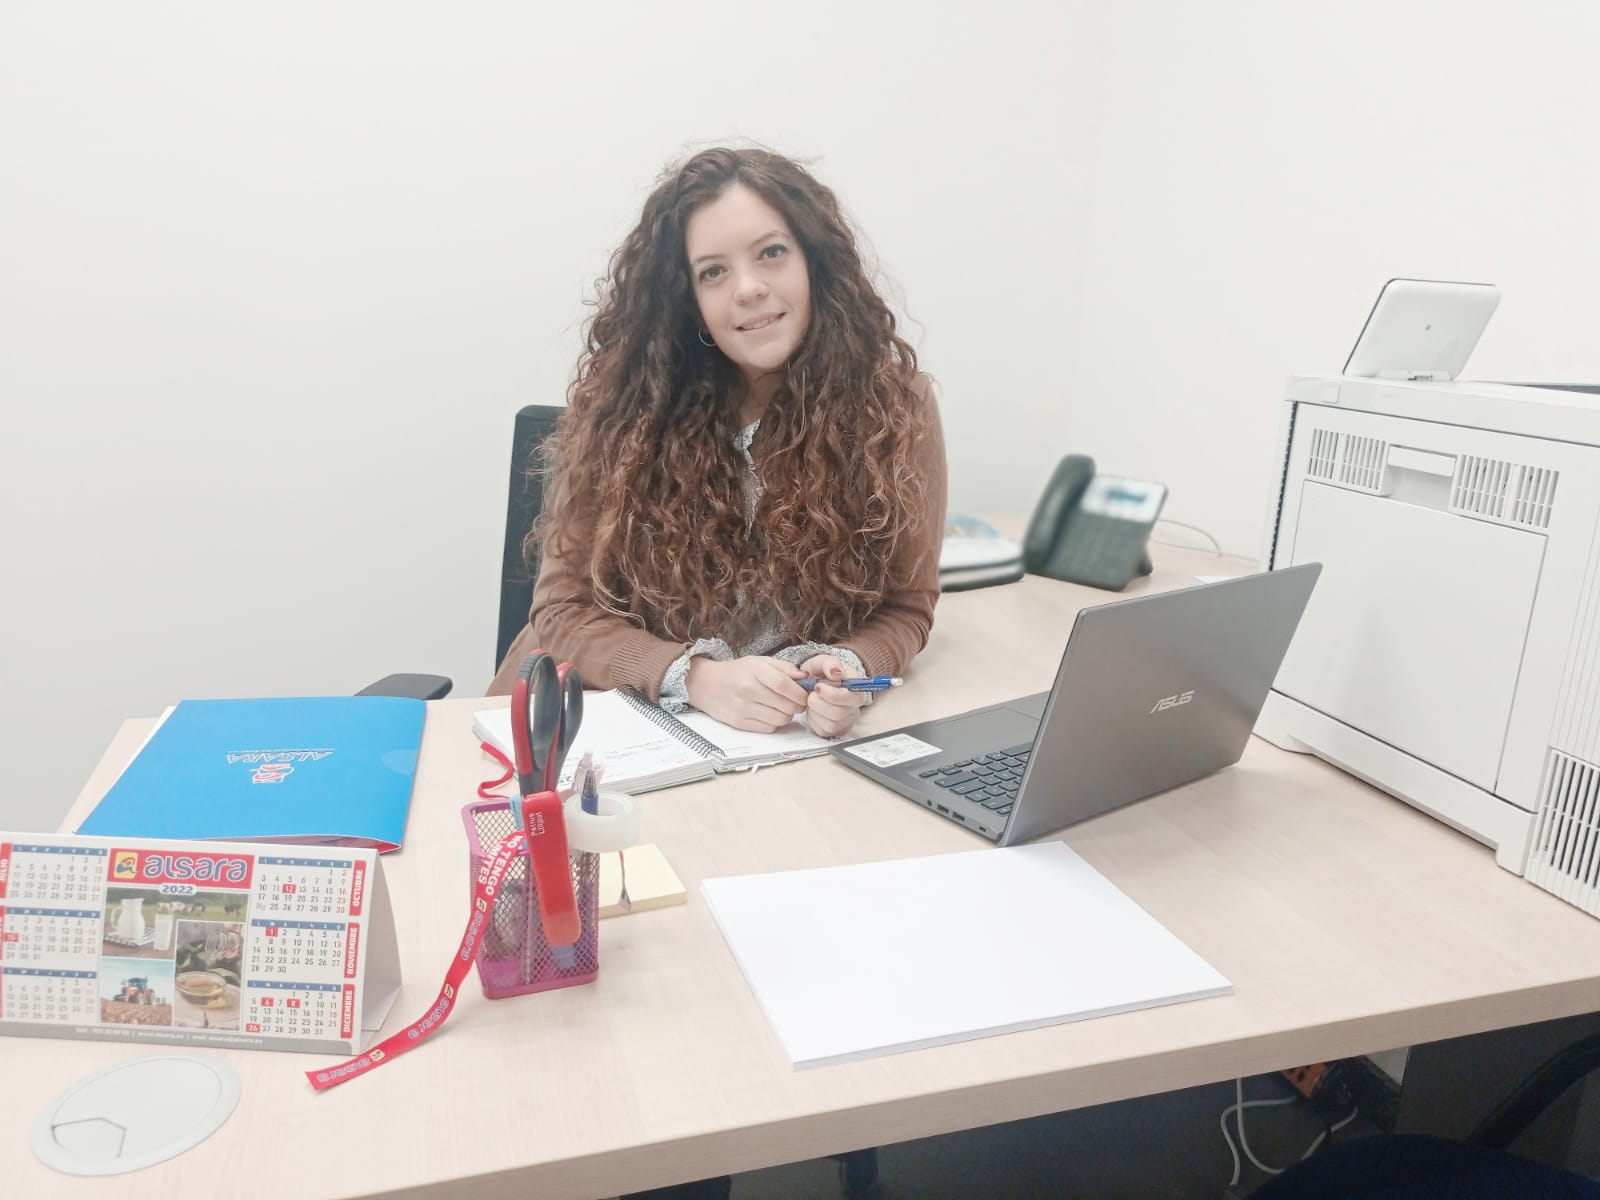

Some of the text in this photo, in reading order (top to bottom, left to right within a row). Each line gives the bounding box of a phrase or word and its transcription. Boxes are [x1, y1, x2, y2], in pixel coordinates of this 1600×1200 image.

[1150, 690, 1195, 714] ASUS
[226, 751, 334, 764] ALSARA
[528, 812, 538, 836] Petrus
[143, 854, 248, 882] alsara
[478, 840, 507, 885] LIMITES
[485, 835, 523, 896] NO TENGO
[162, 884, 194, 894] 2022
[352, 869, 363, 907] OCTUBRE
[347, 927, 358, 975] NOVIEMBRE
[343, 990, 353, 1033] DICIEMBRE
